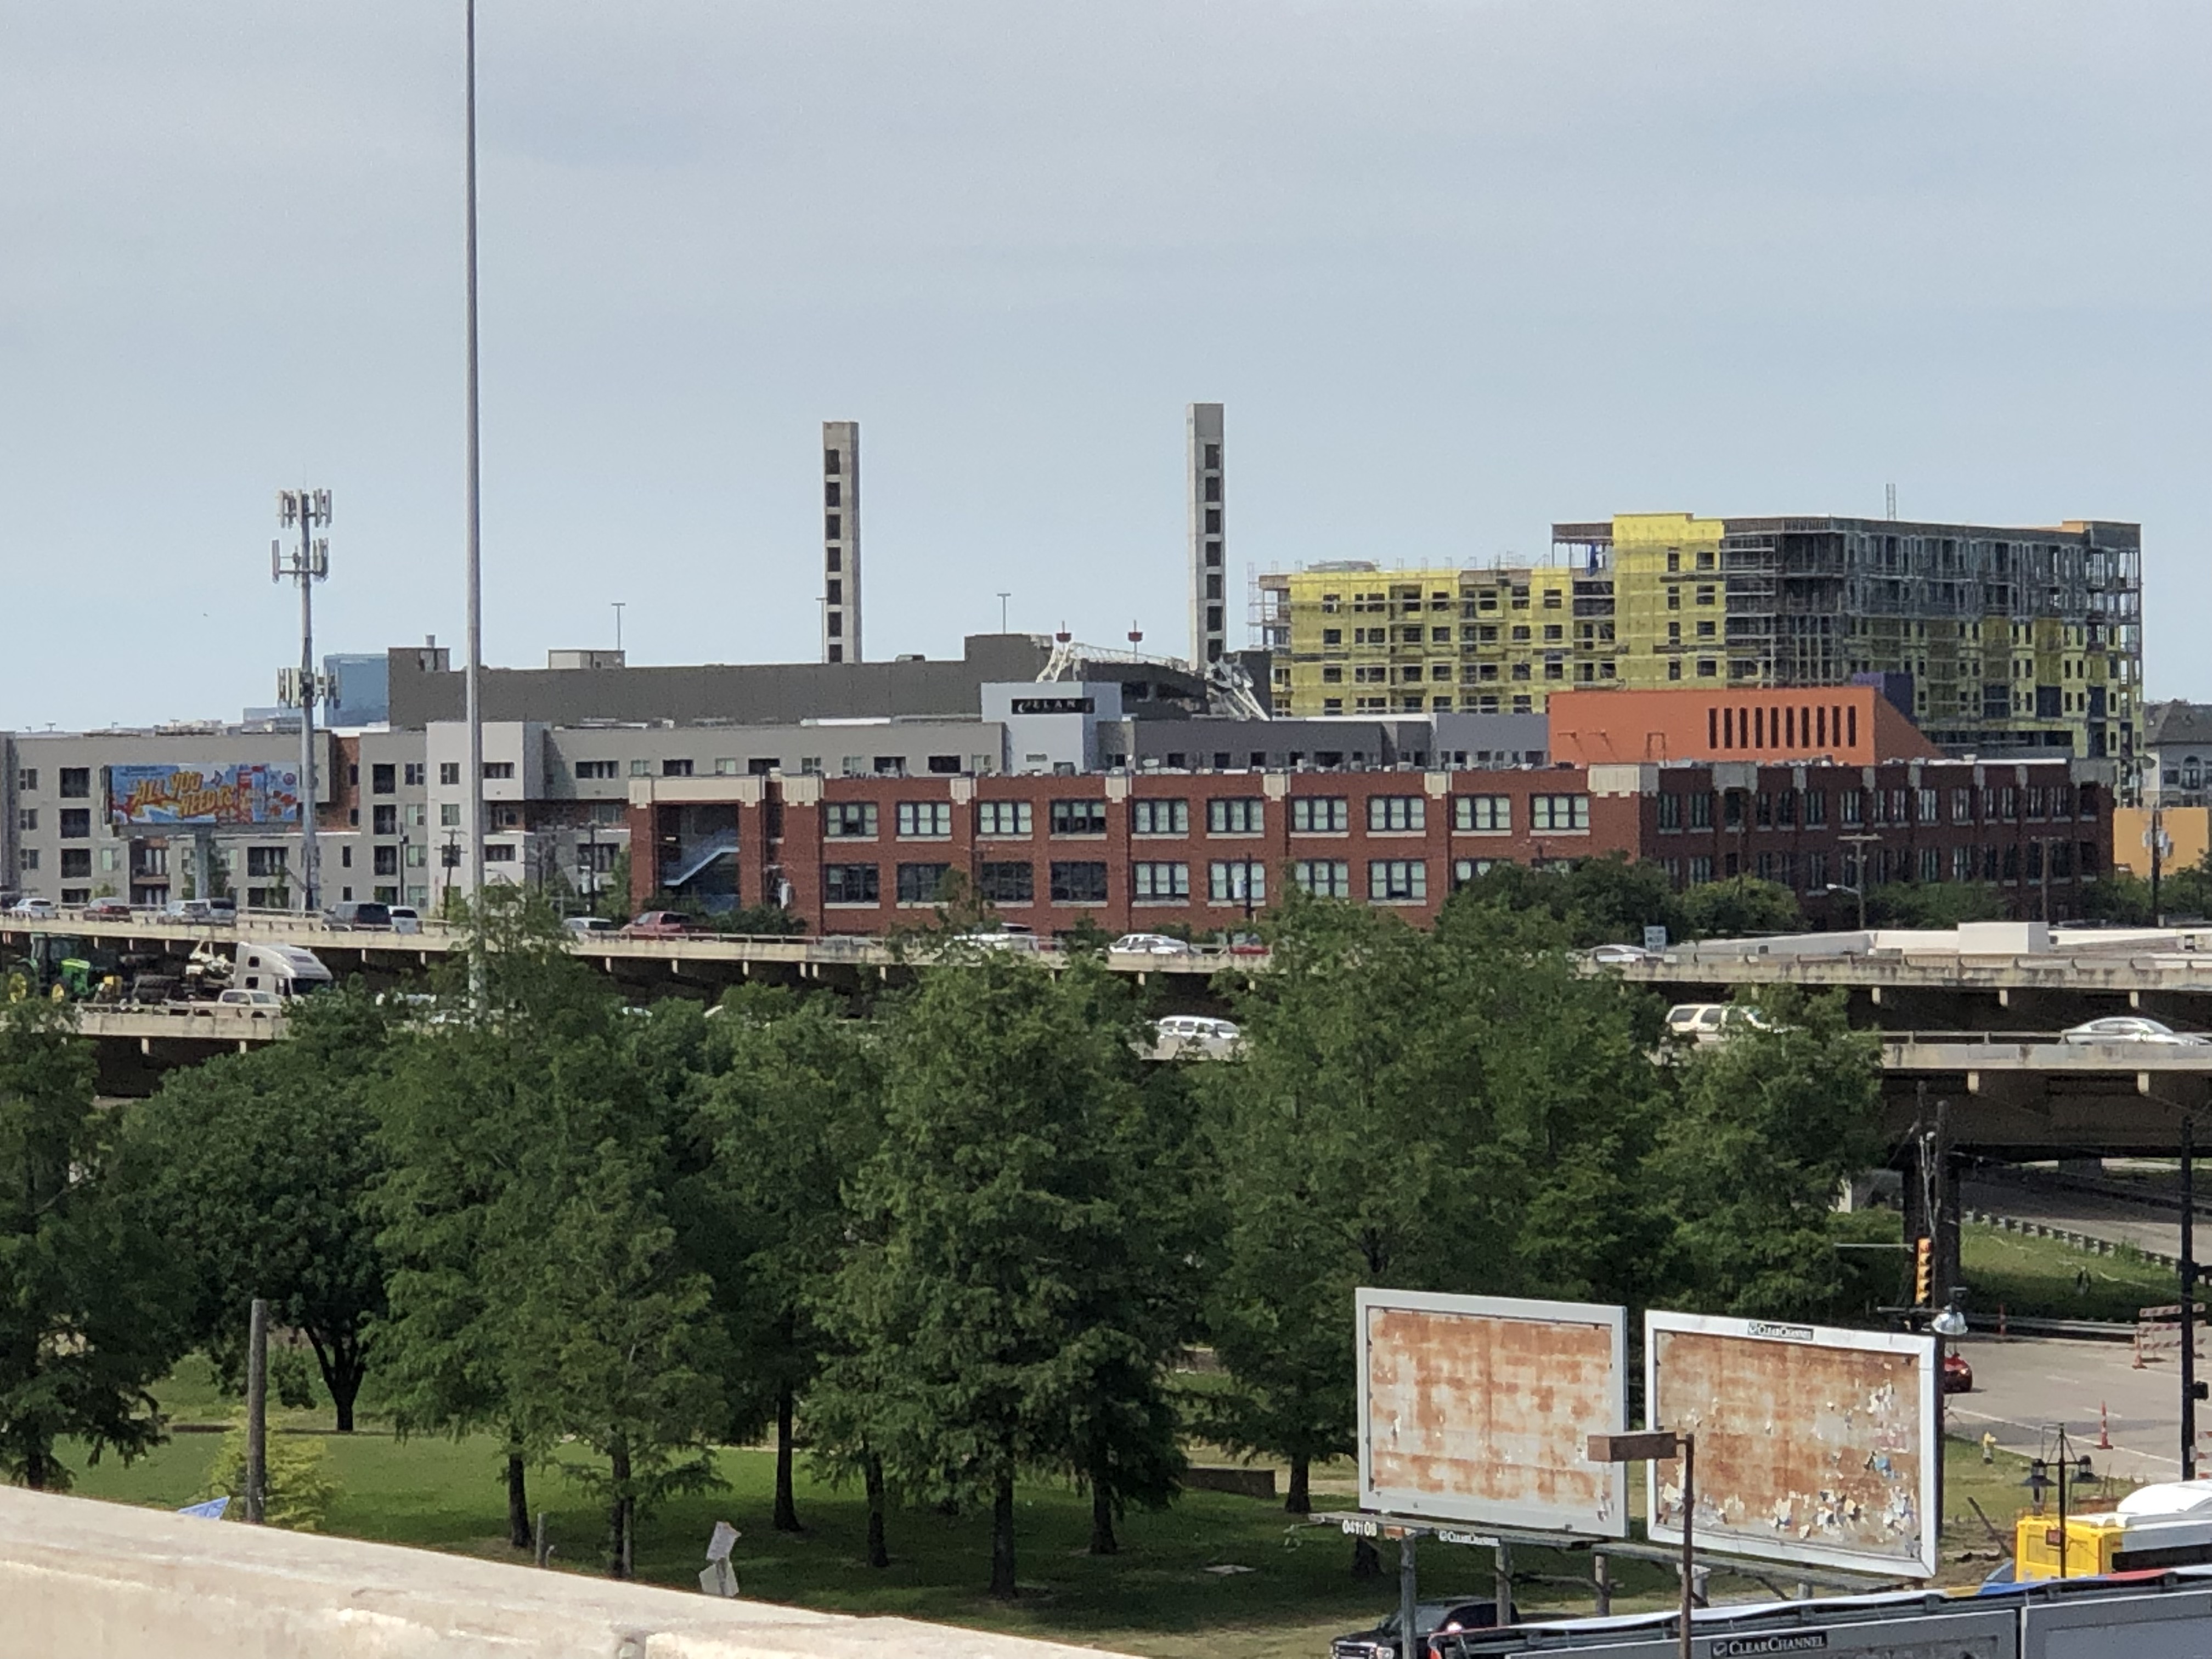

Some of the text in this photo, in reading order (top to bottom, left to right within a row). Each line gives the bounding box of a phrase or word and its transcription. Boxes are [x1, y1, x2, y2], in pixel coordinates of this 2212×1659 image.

[131, 771, 204, 811] ALL YOU
[179, 790, 217, 818] NEED
